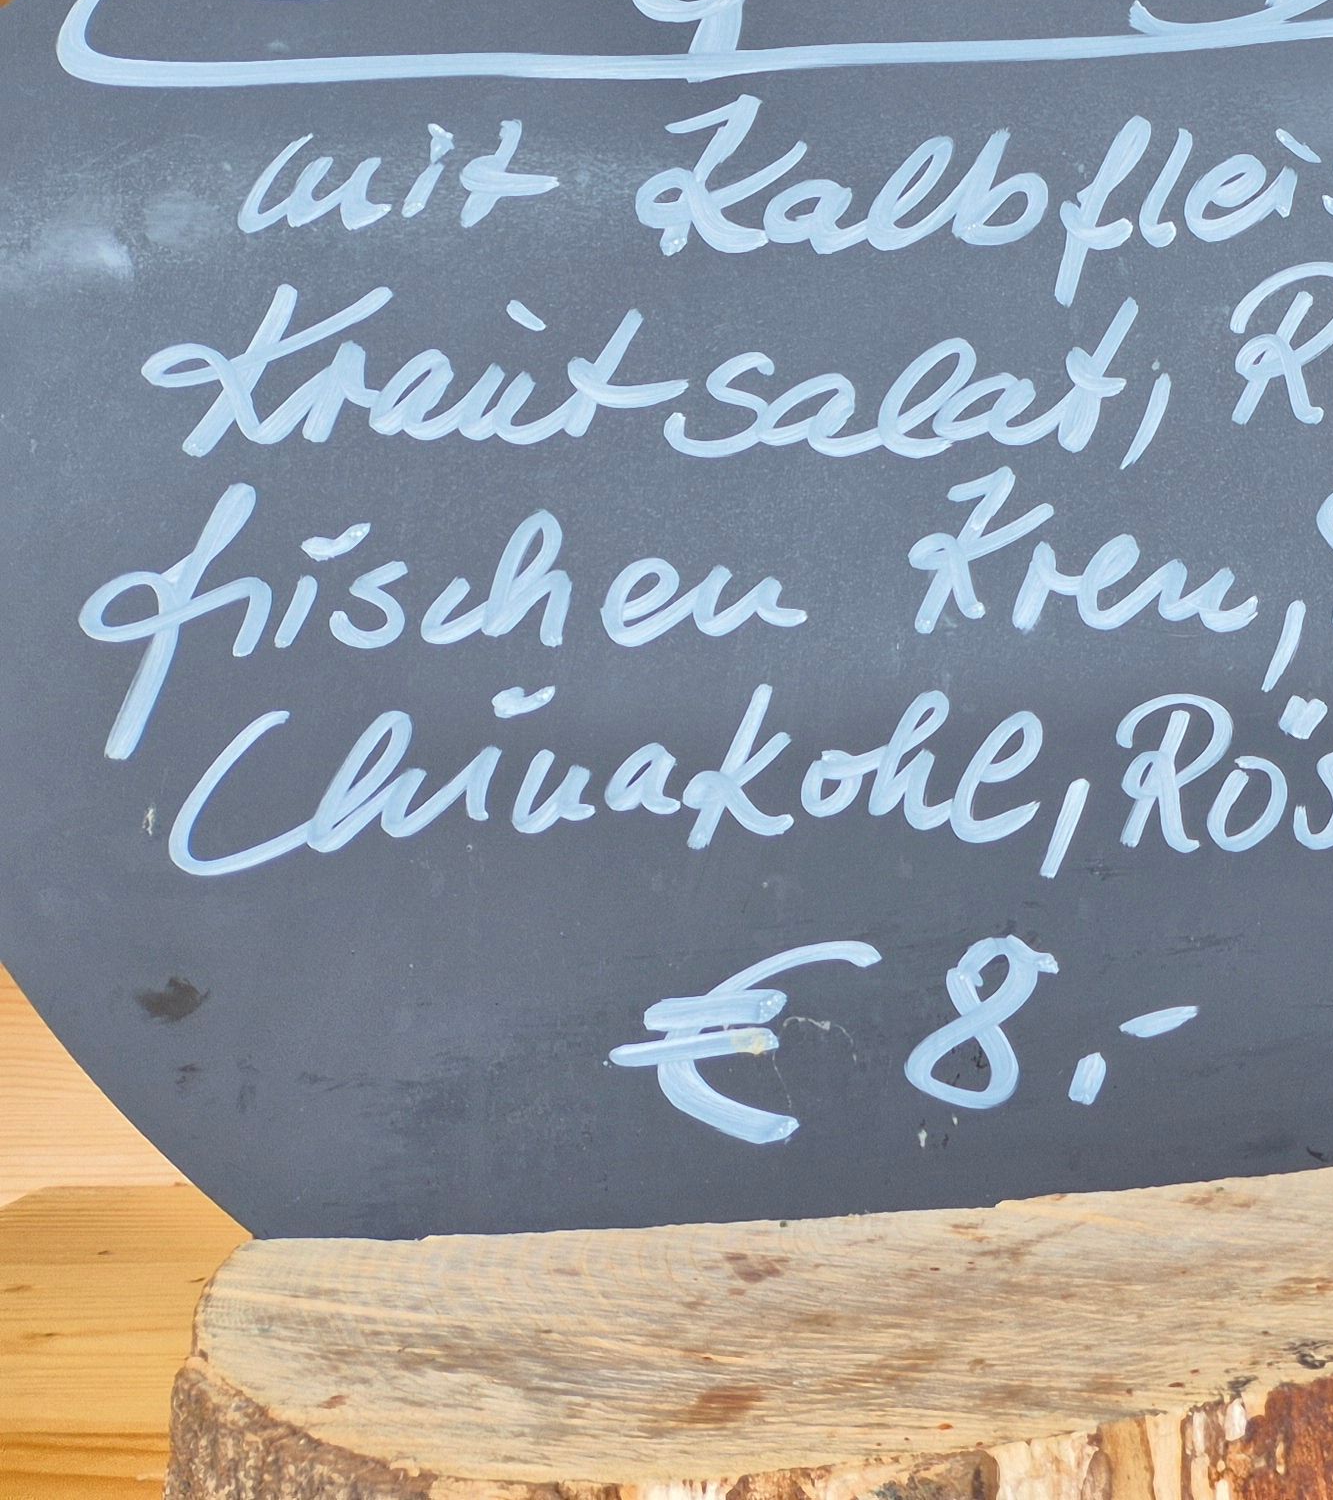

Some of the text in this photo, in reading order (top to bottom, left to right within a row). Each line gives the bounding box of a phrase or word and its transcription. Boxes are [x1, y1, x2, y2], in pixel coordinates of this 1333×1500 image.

[238, 119, 558, 233] mit
[141, 284, 1171, 470] Krautsalat,
[78, 483, 808, 759] frischen
[169, 684, 1091, 878] Chinakohl,
[608, 940, 883, 1145] €
